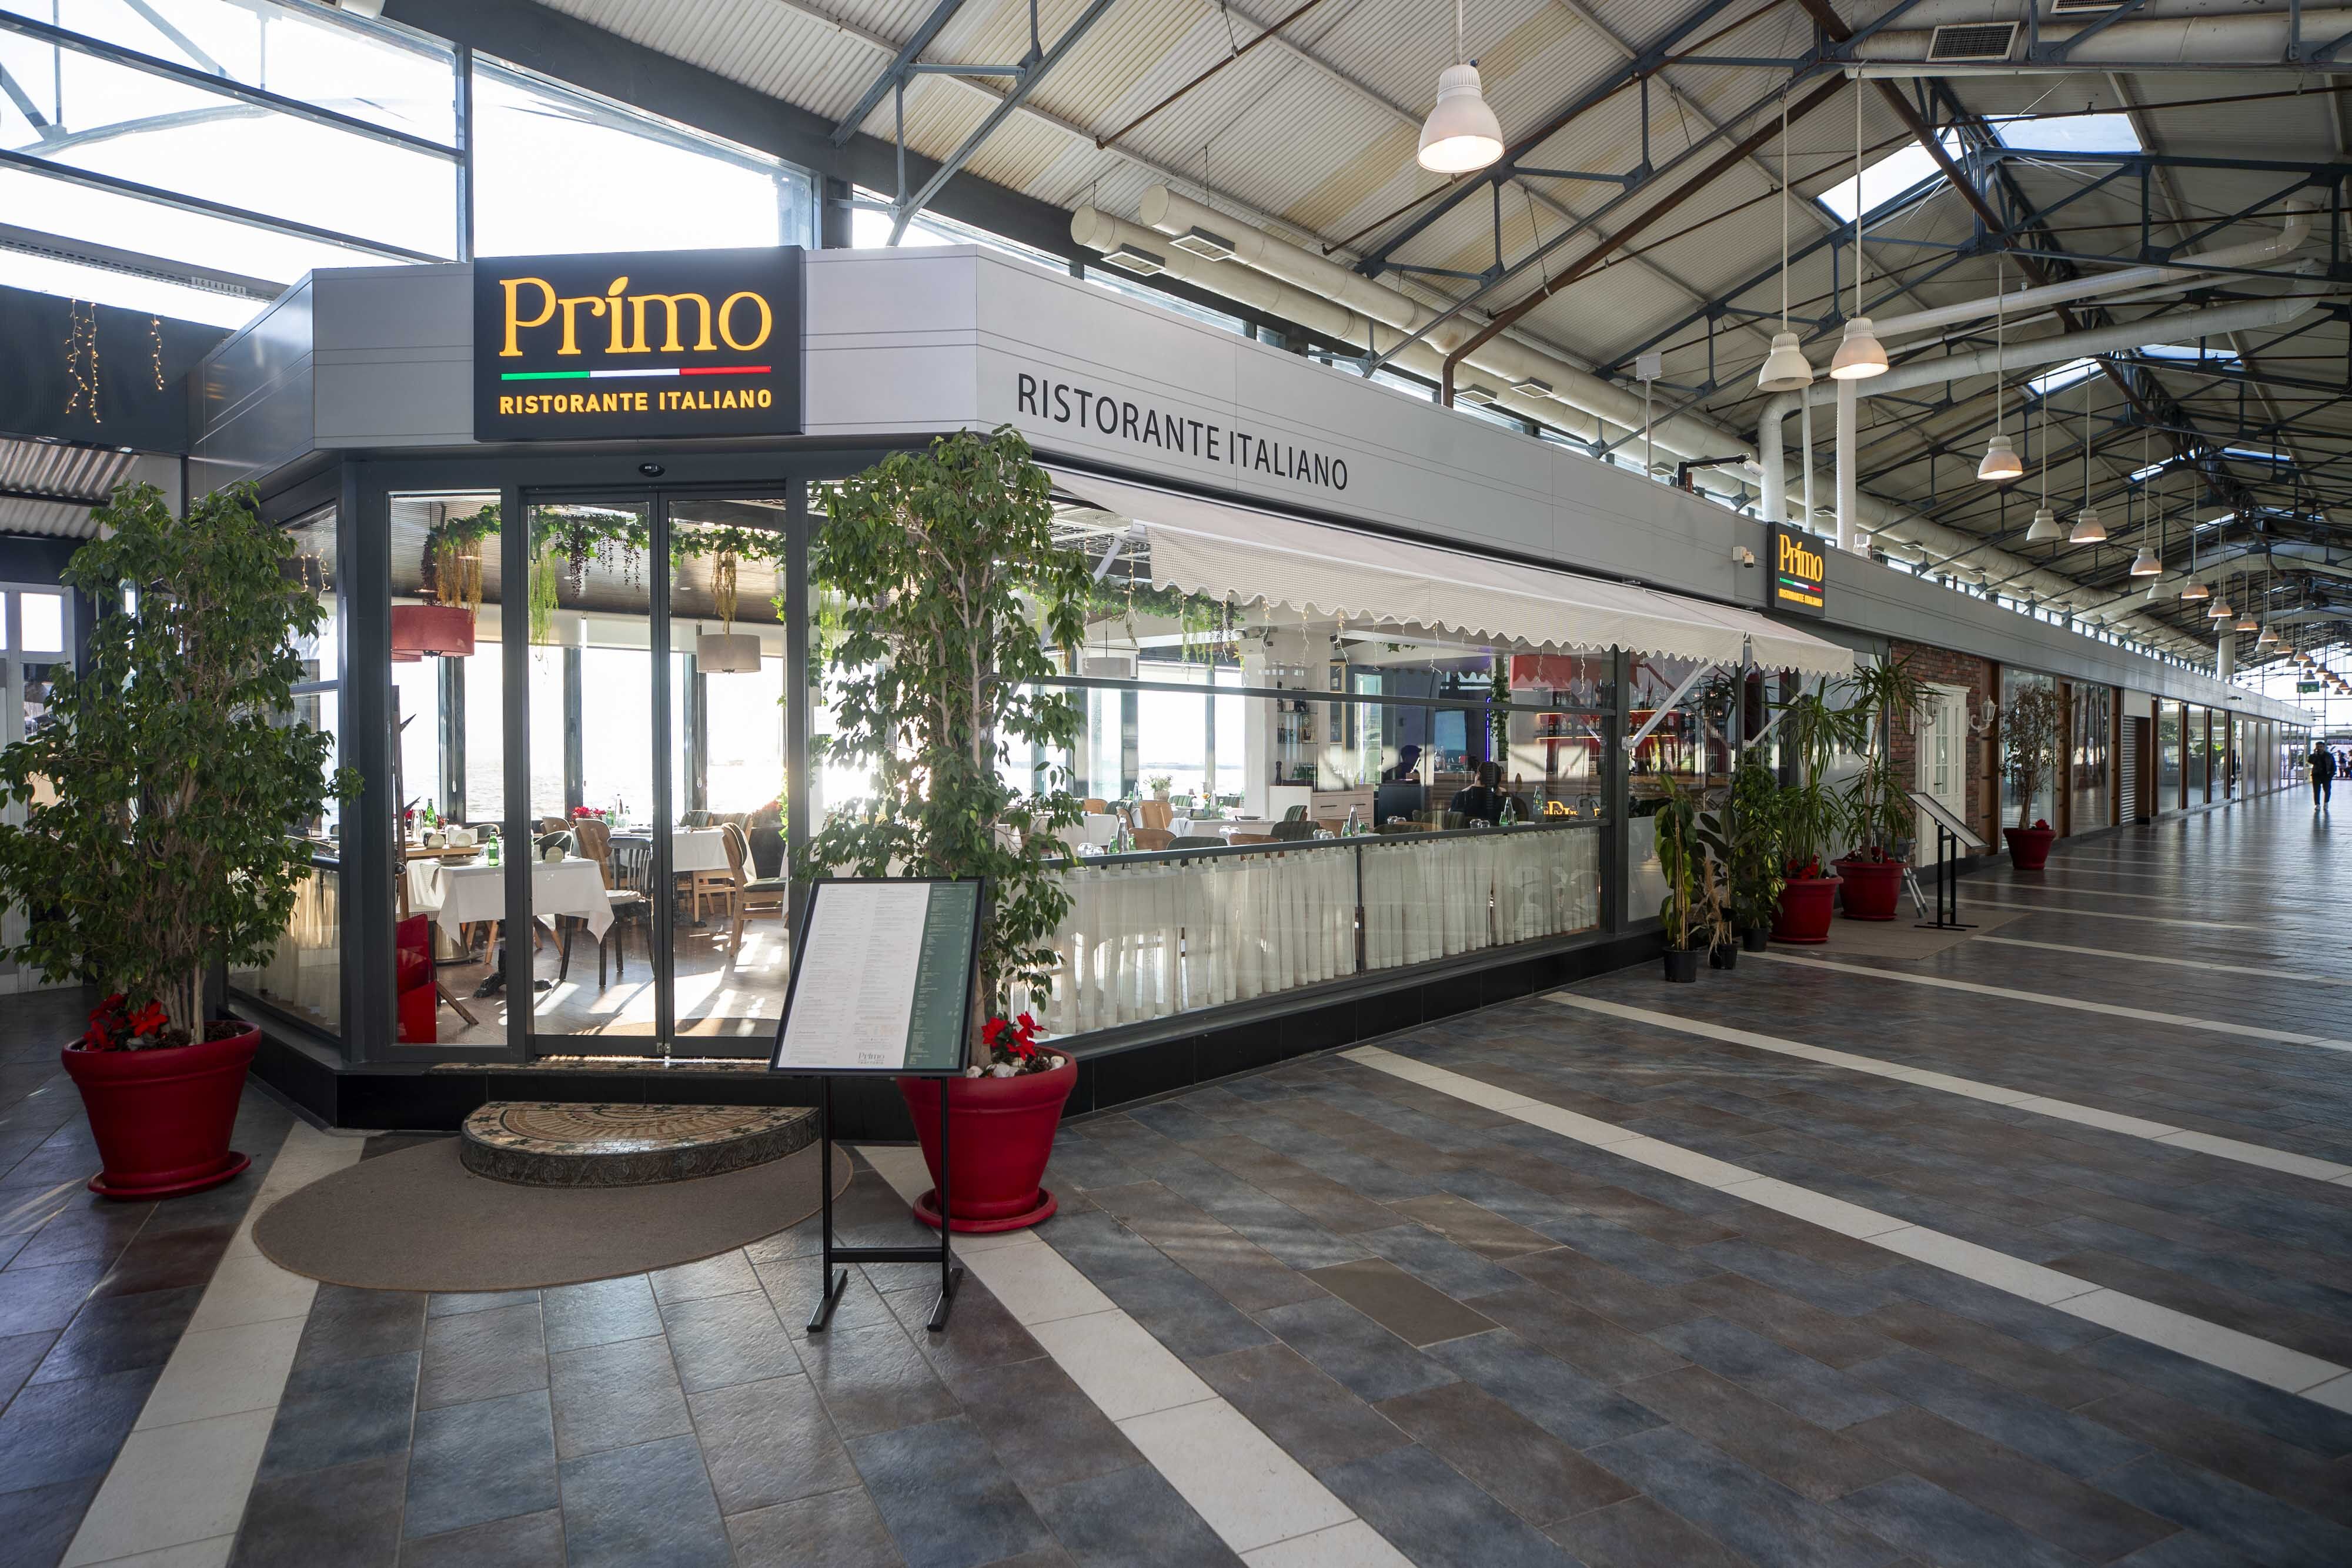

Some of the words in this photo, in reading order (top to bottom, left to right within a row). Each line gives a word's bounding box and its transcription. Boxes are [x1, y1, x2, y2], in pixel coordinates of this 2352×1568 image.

[499, 392, 648, 414] RISTORANTE
[659, 389, 772, 410] ITALIANO
[1018, 373, 1220, 462] RISTORANTE
[1229, 431, 1348, 492] ITALIANO
